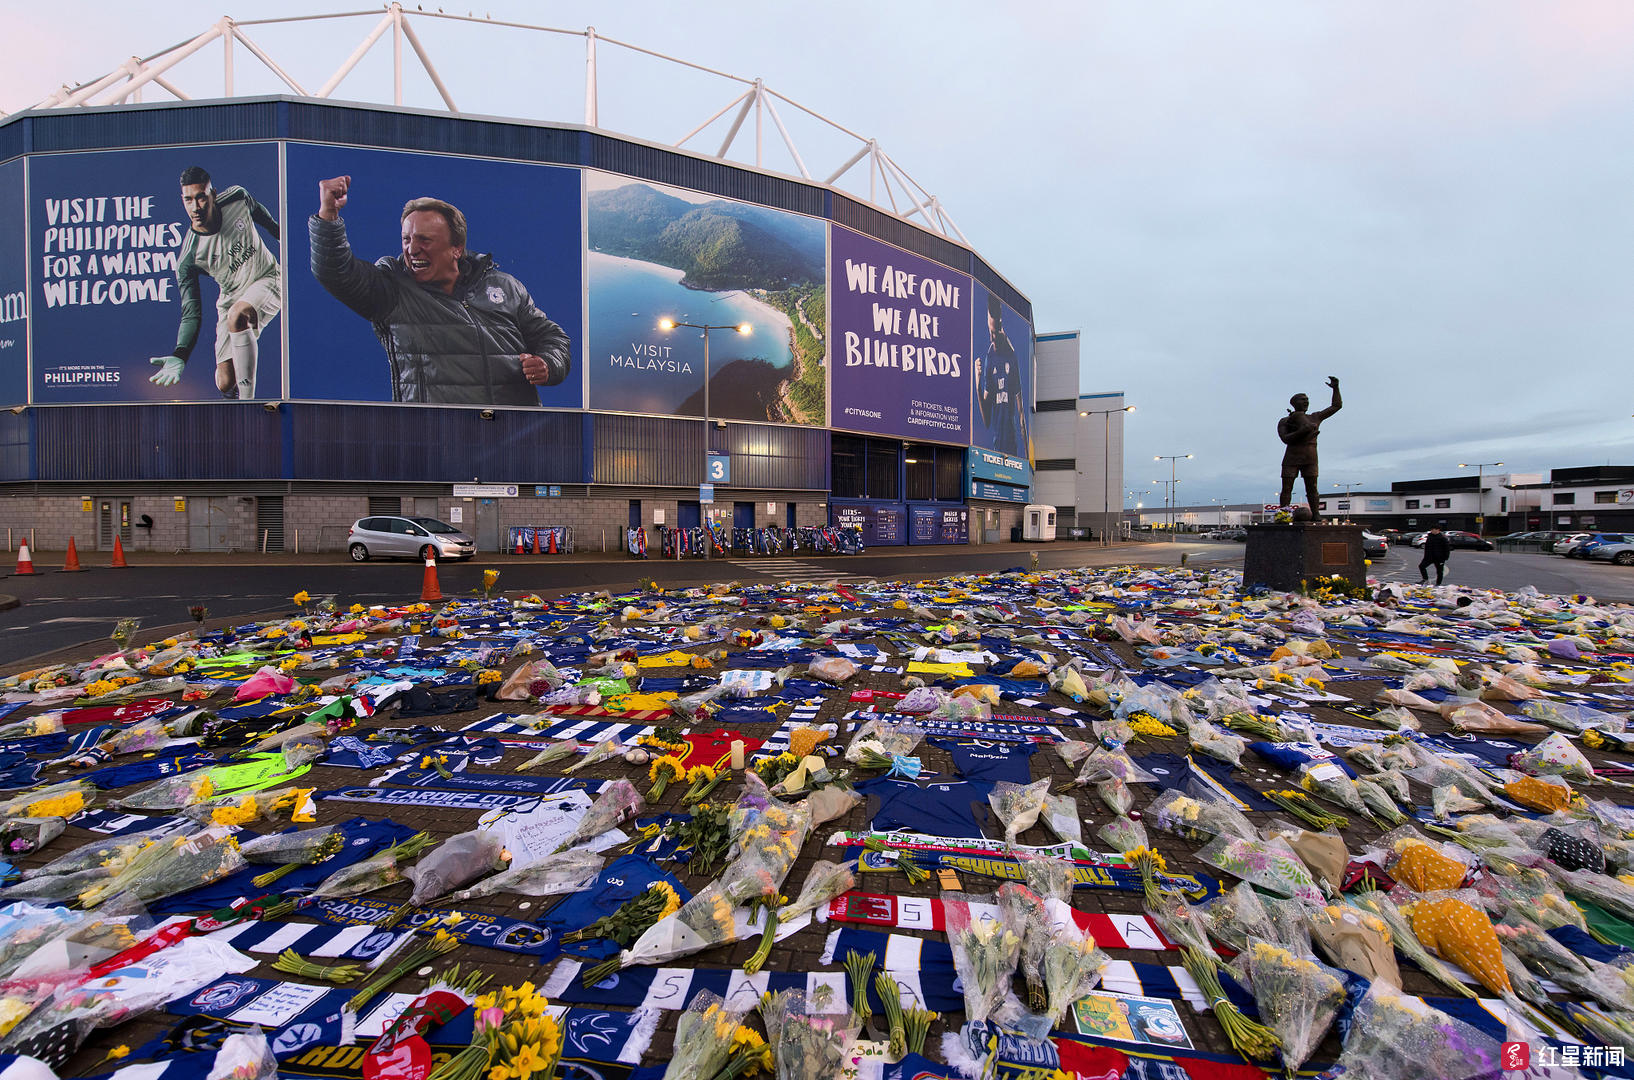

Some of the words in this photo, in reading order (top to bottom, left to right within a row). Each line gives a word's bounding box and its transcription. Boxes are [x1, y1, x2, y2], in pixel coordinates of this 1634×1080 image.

[45, 197, 108, 226] VISIT
[112, 196, 155, 221] THE
[44, 222, 182, 253] PHILIPPINES
[43, 255, 82, 278] FOR
[87, 253, 98, 275] A
[102, 251, 177, 276] WARM
[845, 258, 877, 294] WE
[881, 265, 918, 299] ARE
[920, 278, 960, 309] ONE
[43, 277, 174, 308] WELCOME
[872, 302, 902, 336] WE
[907, 308, 940, 340] ARE
[631, 342, 673, 358] VISIT
[844, 331, 962, 378] BLUEBIRDS
[610, 354, 692, 374] MALAYSIA
[44, 371, 120, 383] PHILIPPINES
[844, 407, 882, 419] #CITYASONE
[911, 399, 921, 407] FOR
[943, 405, 958, 414] NEWS
[907, 416, 961, 431] CARDIFFCITYFC.CO.UK
[915, 409, 948, 420] INFORMATION
[948, 414, 959, 422] VISIT
[711, 460, 724, 479] 3
[983, 453, 1004, 466] TICKET
[1004, 459, 1023, 470] OFFICE
[386, 789, 478, 802] CARDIFF
[361, 898, 388, 910] CUP
[324, 909, 346, 924] THE
[468, 920, 502, 937] FC
[1126, 921, 1153, 939] A
[653, 976, 684, 999] S
[729, 980, 760, 1000] A
[856, 1044, 883, 1056] Sala
